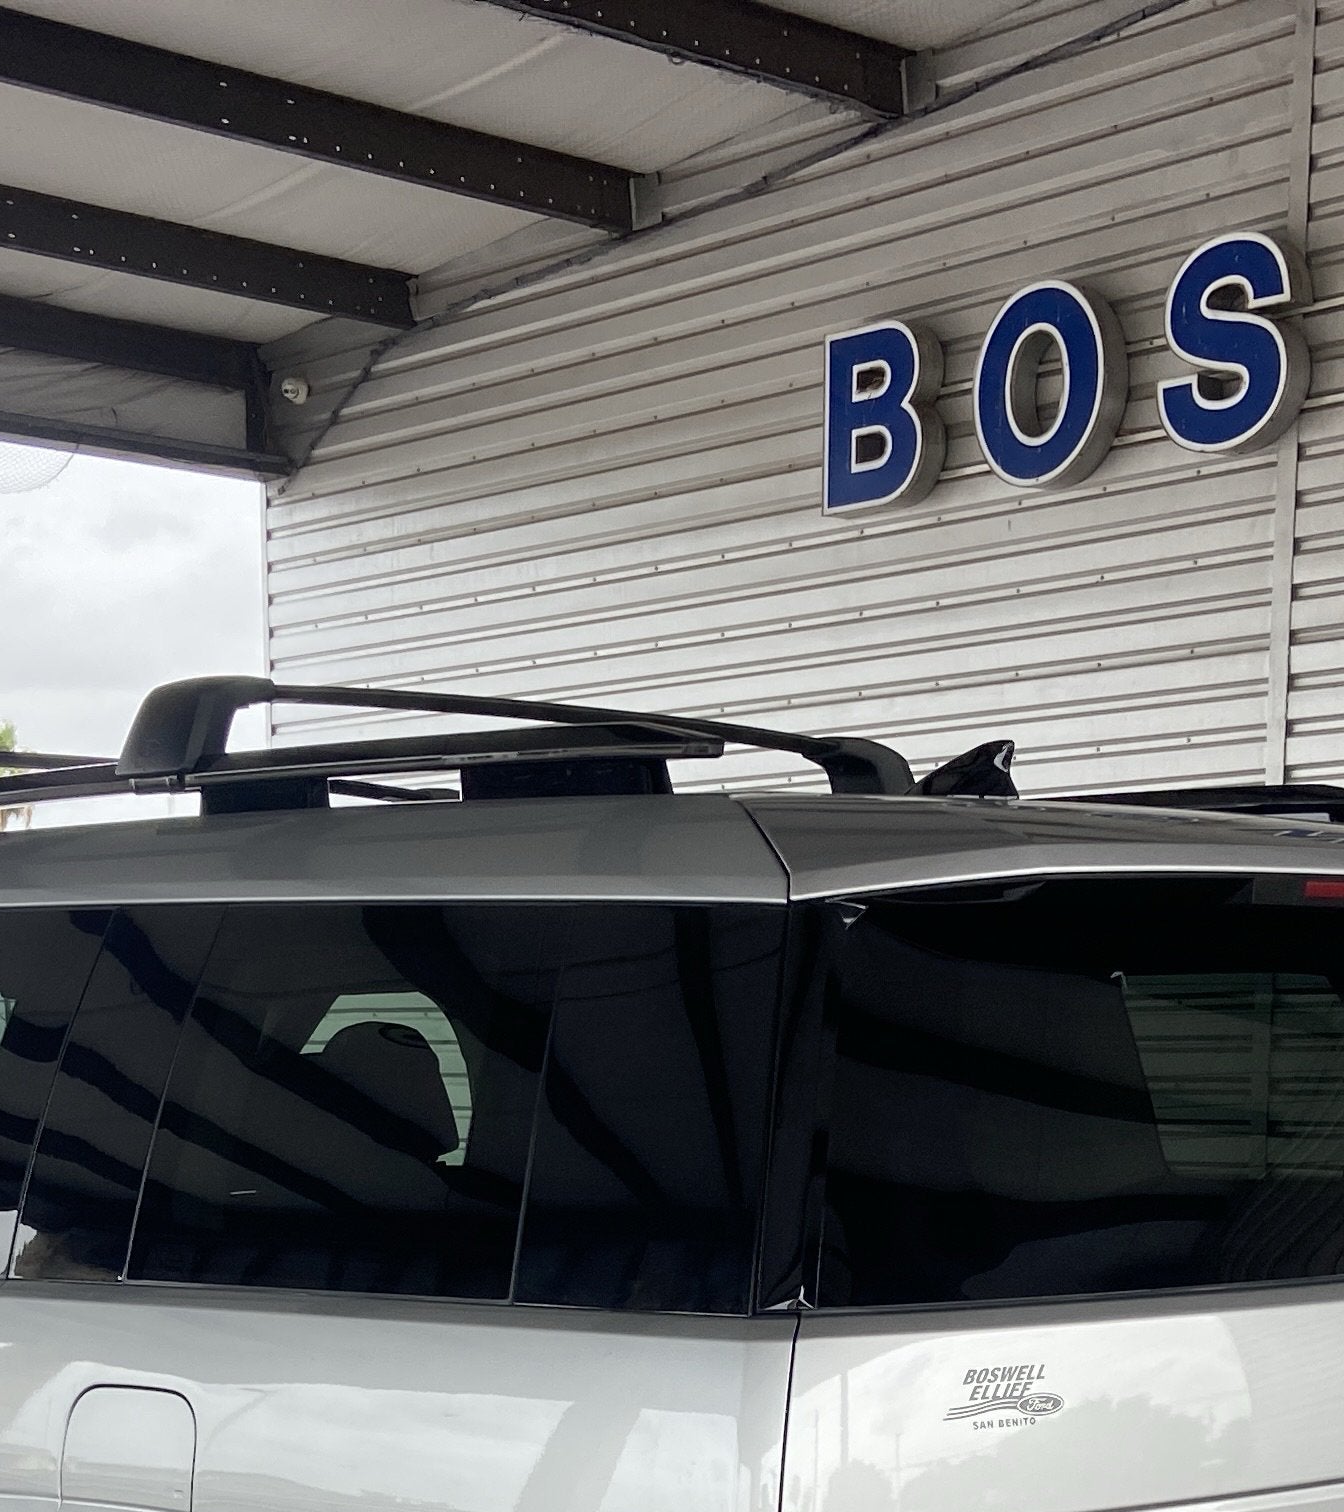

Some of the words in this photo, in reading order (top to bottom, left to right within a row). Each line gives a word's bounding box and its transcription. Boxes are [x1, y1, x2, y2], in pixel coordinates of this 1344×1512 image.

[963, 1364, 1045, 1385] BOSWELL
[969, 1382, 1033, 1401] ELLIFF
[972, 1420, 994, 1430] SAN
[998, 1417, 1037, 1428] BENITO
